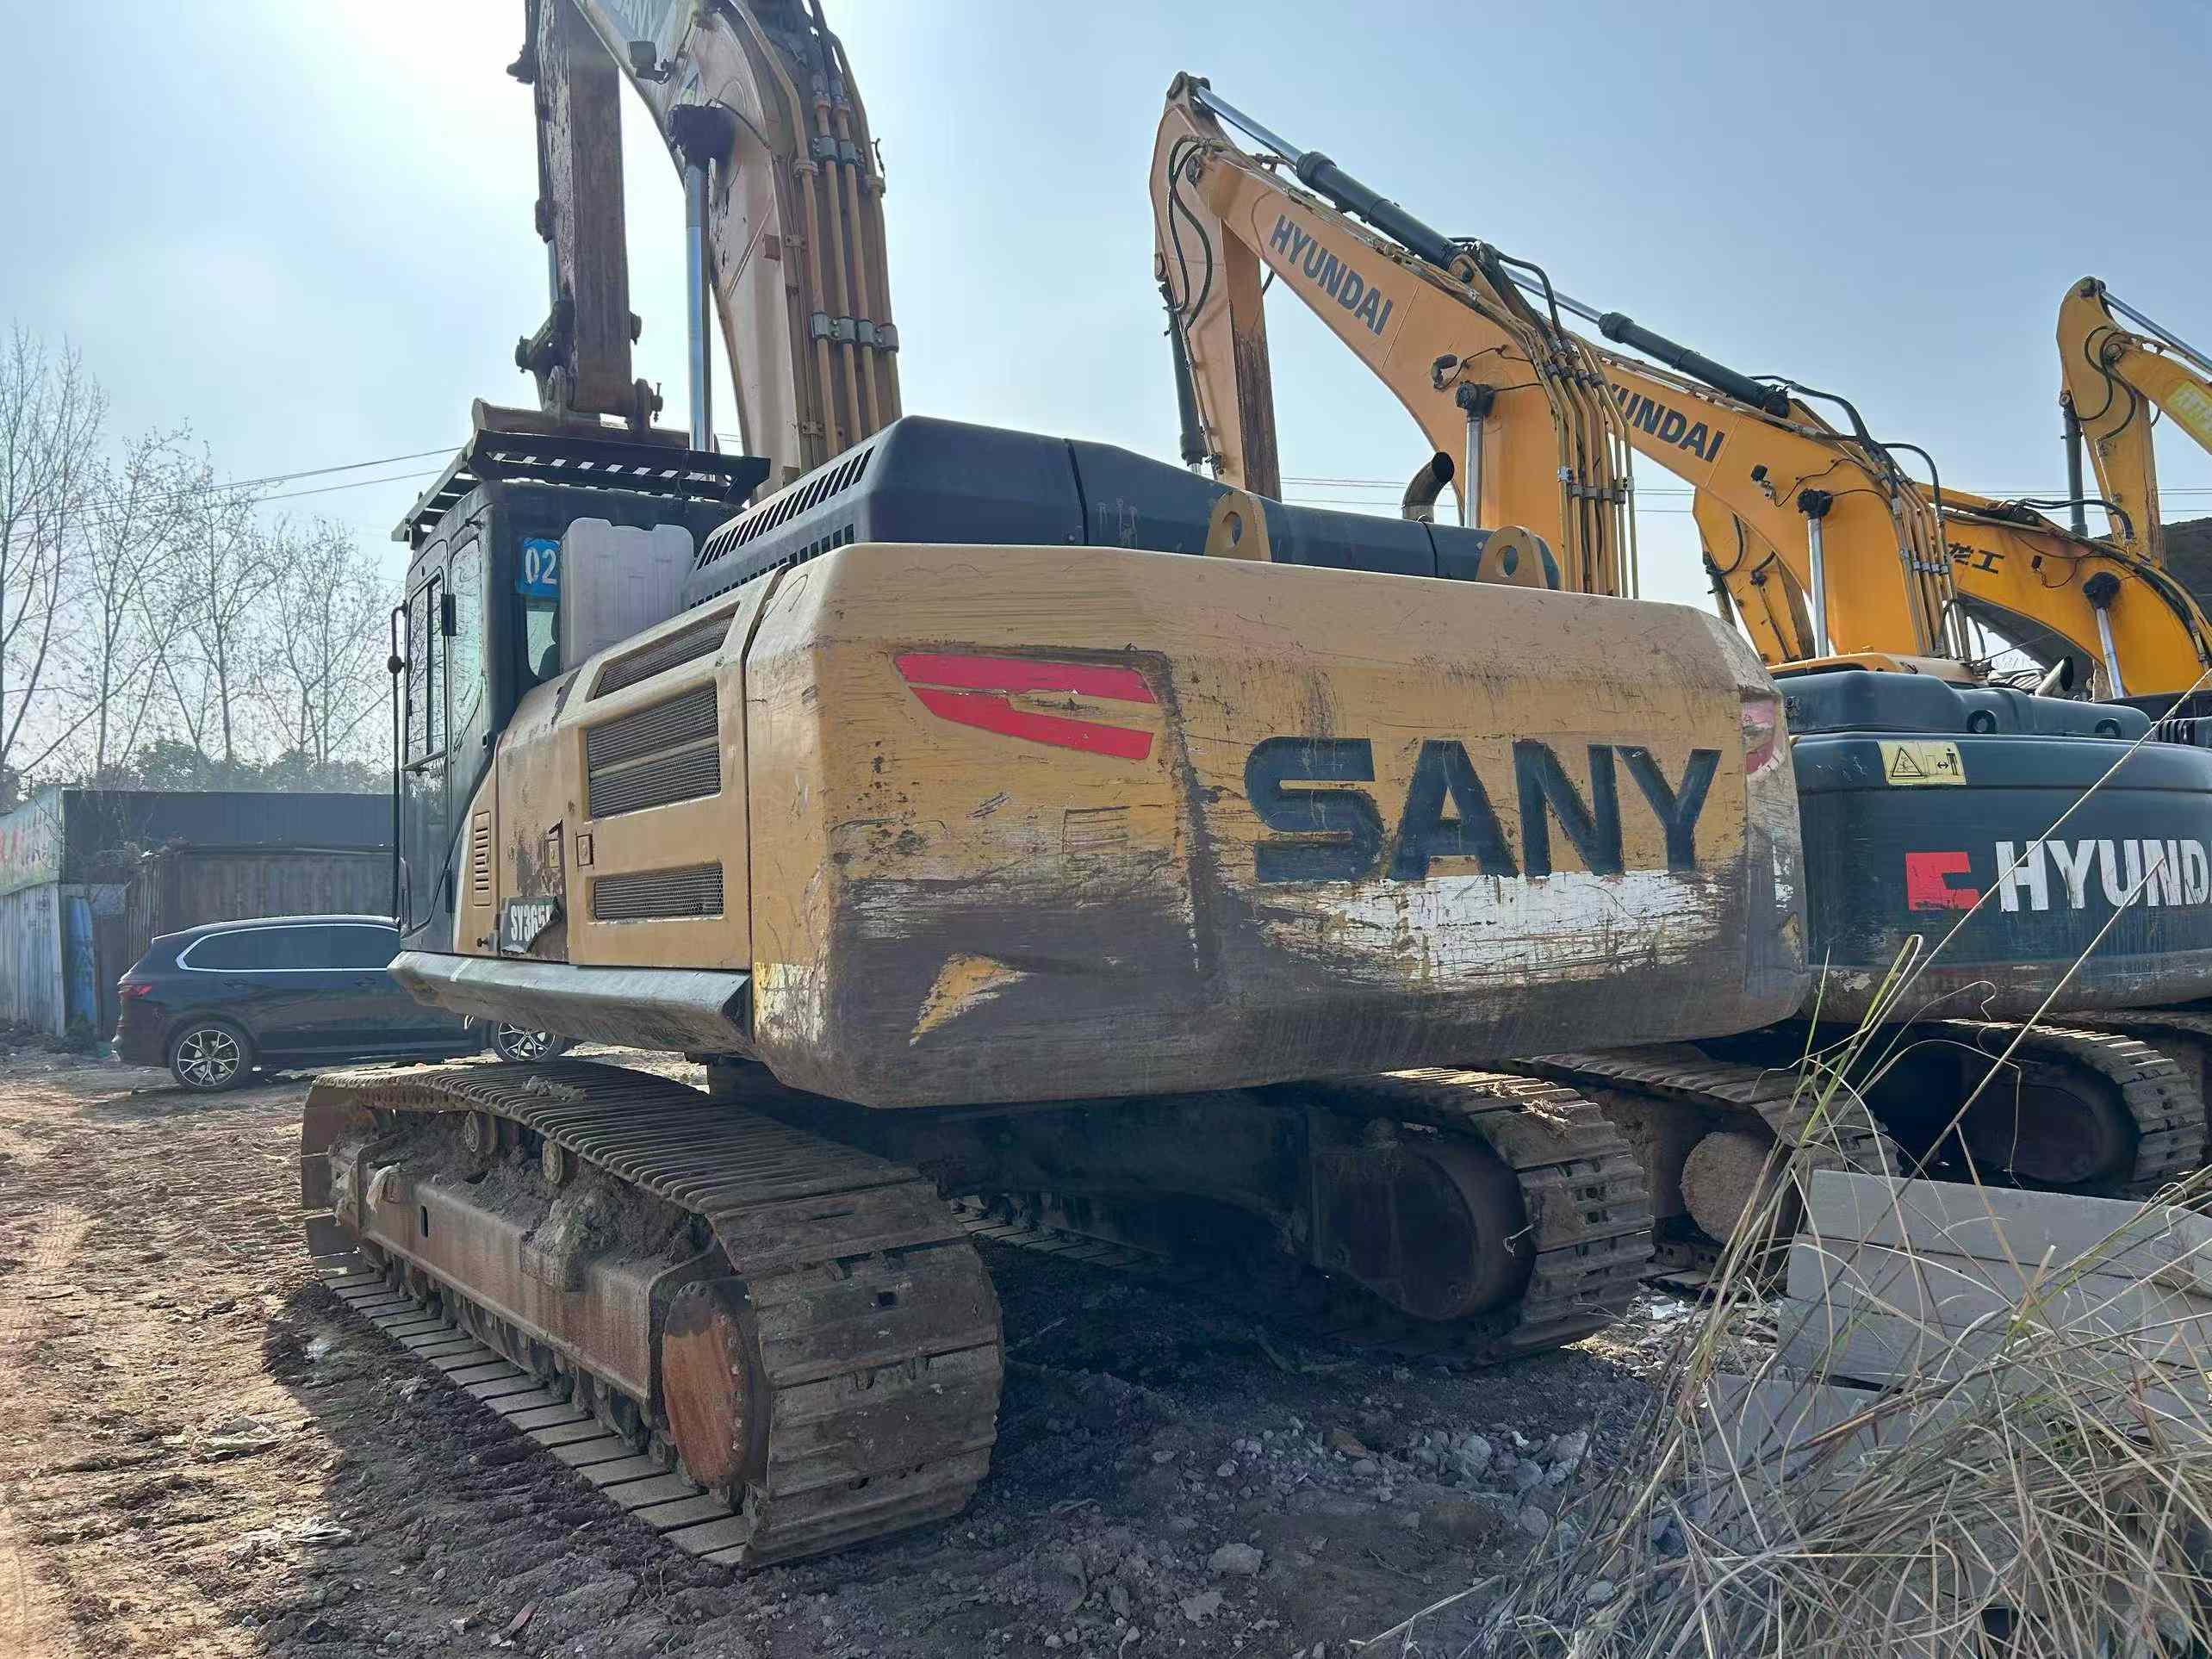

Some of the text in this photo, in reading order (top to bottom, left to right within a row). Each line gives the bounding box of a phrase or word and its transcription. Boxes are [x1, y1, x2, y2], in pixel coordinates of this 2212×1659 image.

[1269, 214, 1393, 336] HYUNDAI
[1612, 384, 1725, 463] UNDAI
[525, 547, 558, 585] 02
[1244, 736, 1723, 884] SANY
[1995, 839, 2212, 912] HYUND
